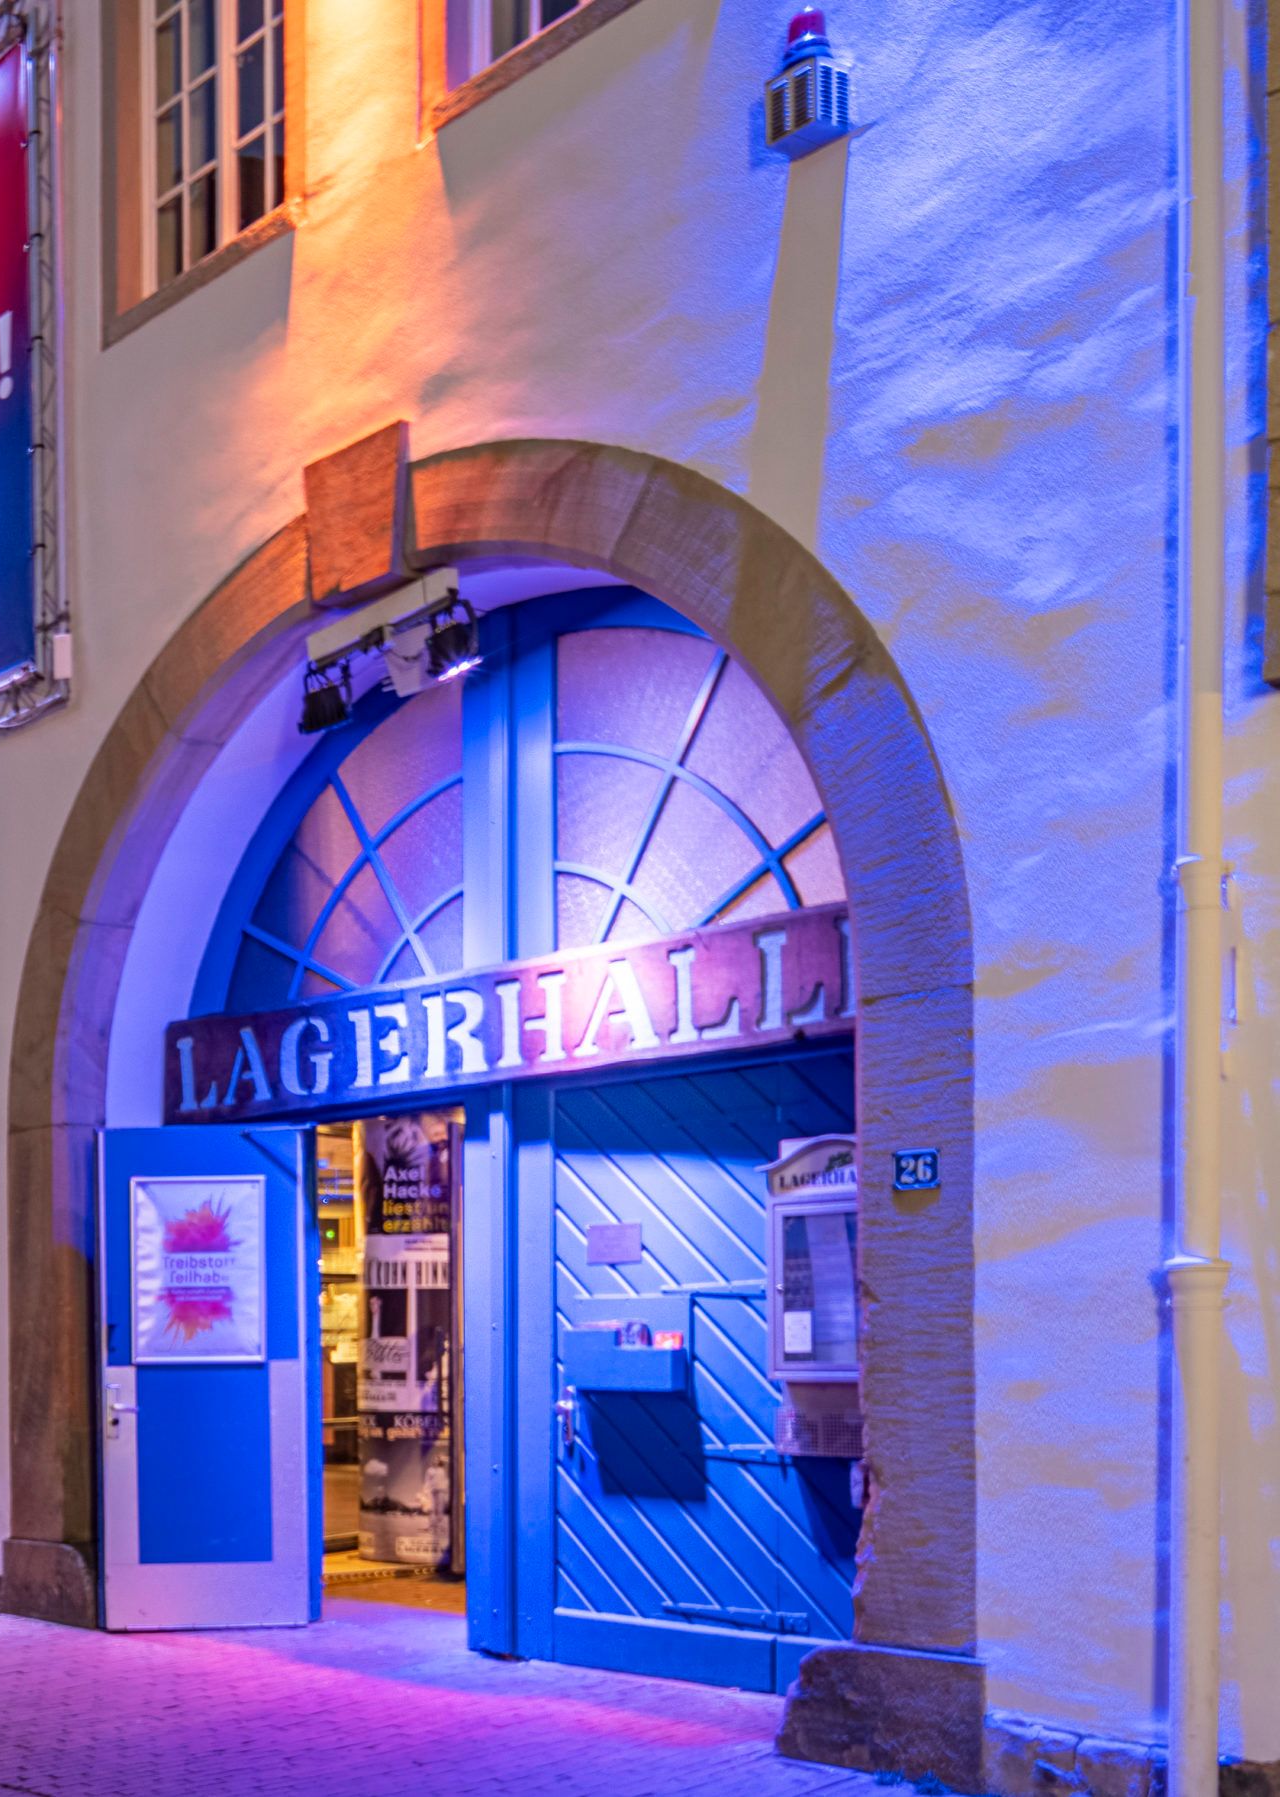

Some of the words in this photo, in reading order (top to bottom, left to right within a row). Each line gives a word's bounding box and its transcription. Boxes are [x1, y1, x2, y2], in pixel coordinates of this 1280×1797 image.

[177, 916, 855, 1111] LAGERHALL
[384, 1165, 425, 1182] Axel
[899, 1153, 933, 1185] 26
[383, 1182, 442, 1199] Hacke
